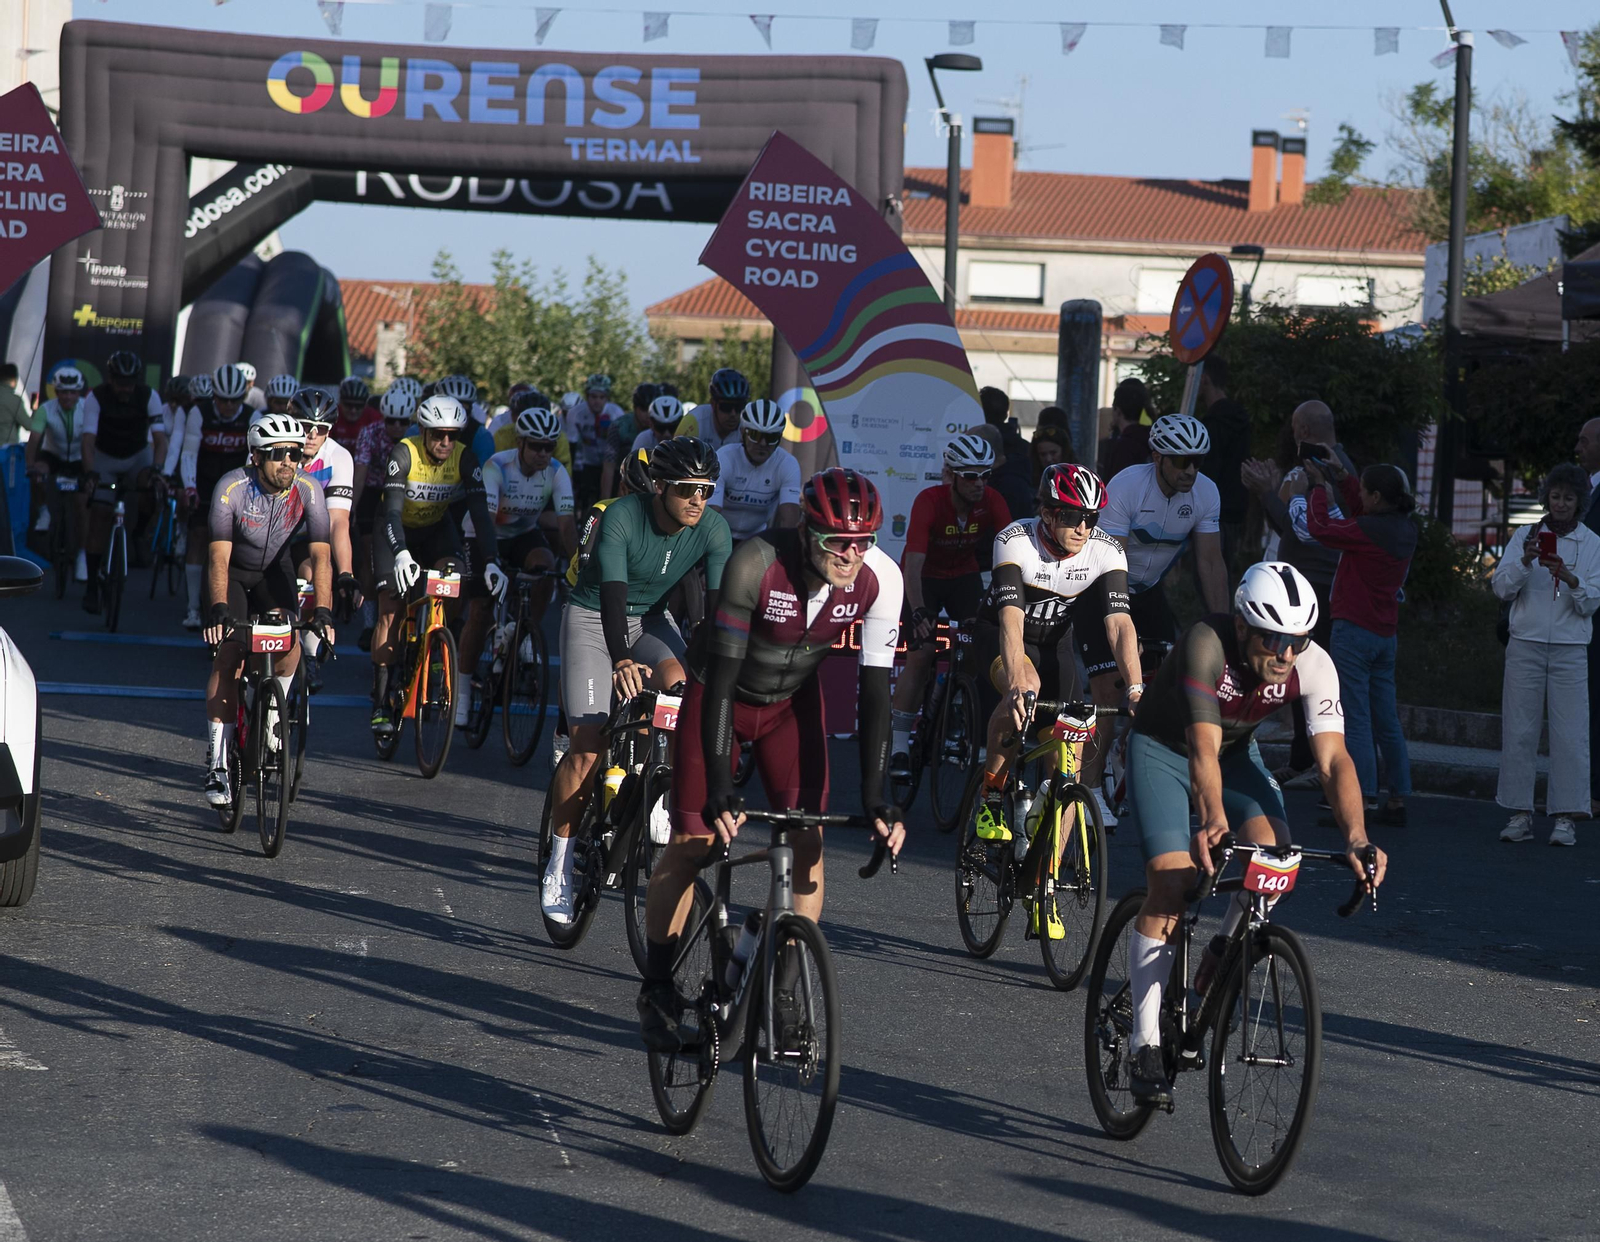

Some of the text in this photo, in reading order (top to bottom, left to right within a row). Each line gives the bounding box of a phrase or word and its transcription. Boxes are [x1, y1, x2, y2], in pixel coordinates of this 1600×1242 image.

[267, 50, 700, 129] OURENSE
[564, 137, 700, 163] TERMAL
[749, 182, 852, 206] RIBEIRA
[0, 191, 66, 212] LING
[747, 210, 837, 233] SACRA
[745, 238, 857, 263] CYCLING
[743, 266, 819, 288] ROAD
[92, 317, 144, 329] DEPORTE
[416, 484, 452, 492] RENAULT
[435, 583, 451, 595] 38
[769, 590, 798, 602] RIBEIRA
[768, 598, 793, 609] SACRA
[765, 607, 798, 617] CYCLING
[832, 603, 859, 618] OU
[763, 613, 786, 623] ROAD
[260, 639, 284, 651] 102
[1062, 730, 1088, 742] 182
[1257, 873, 1289, 891] 140
